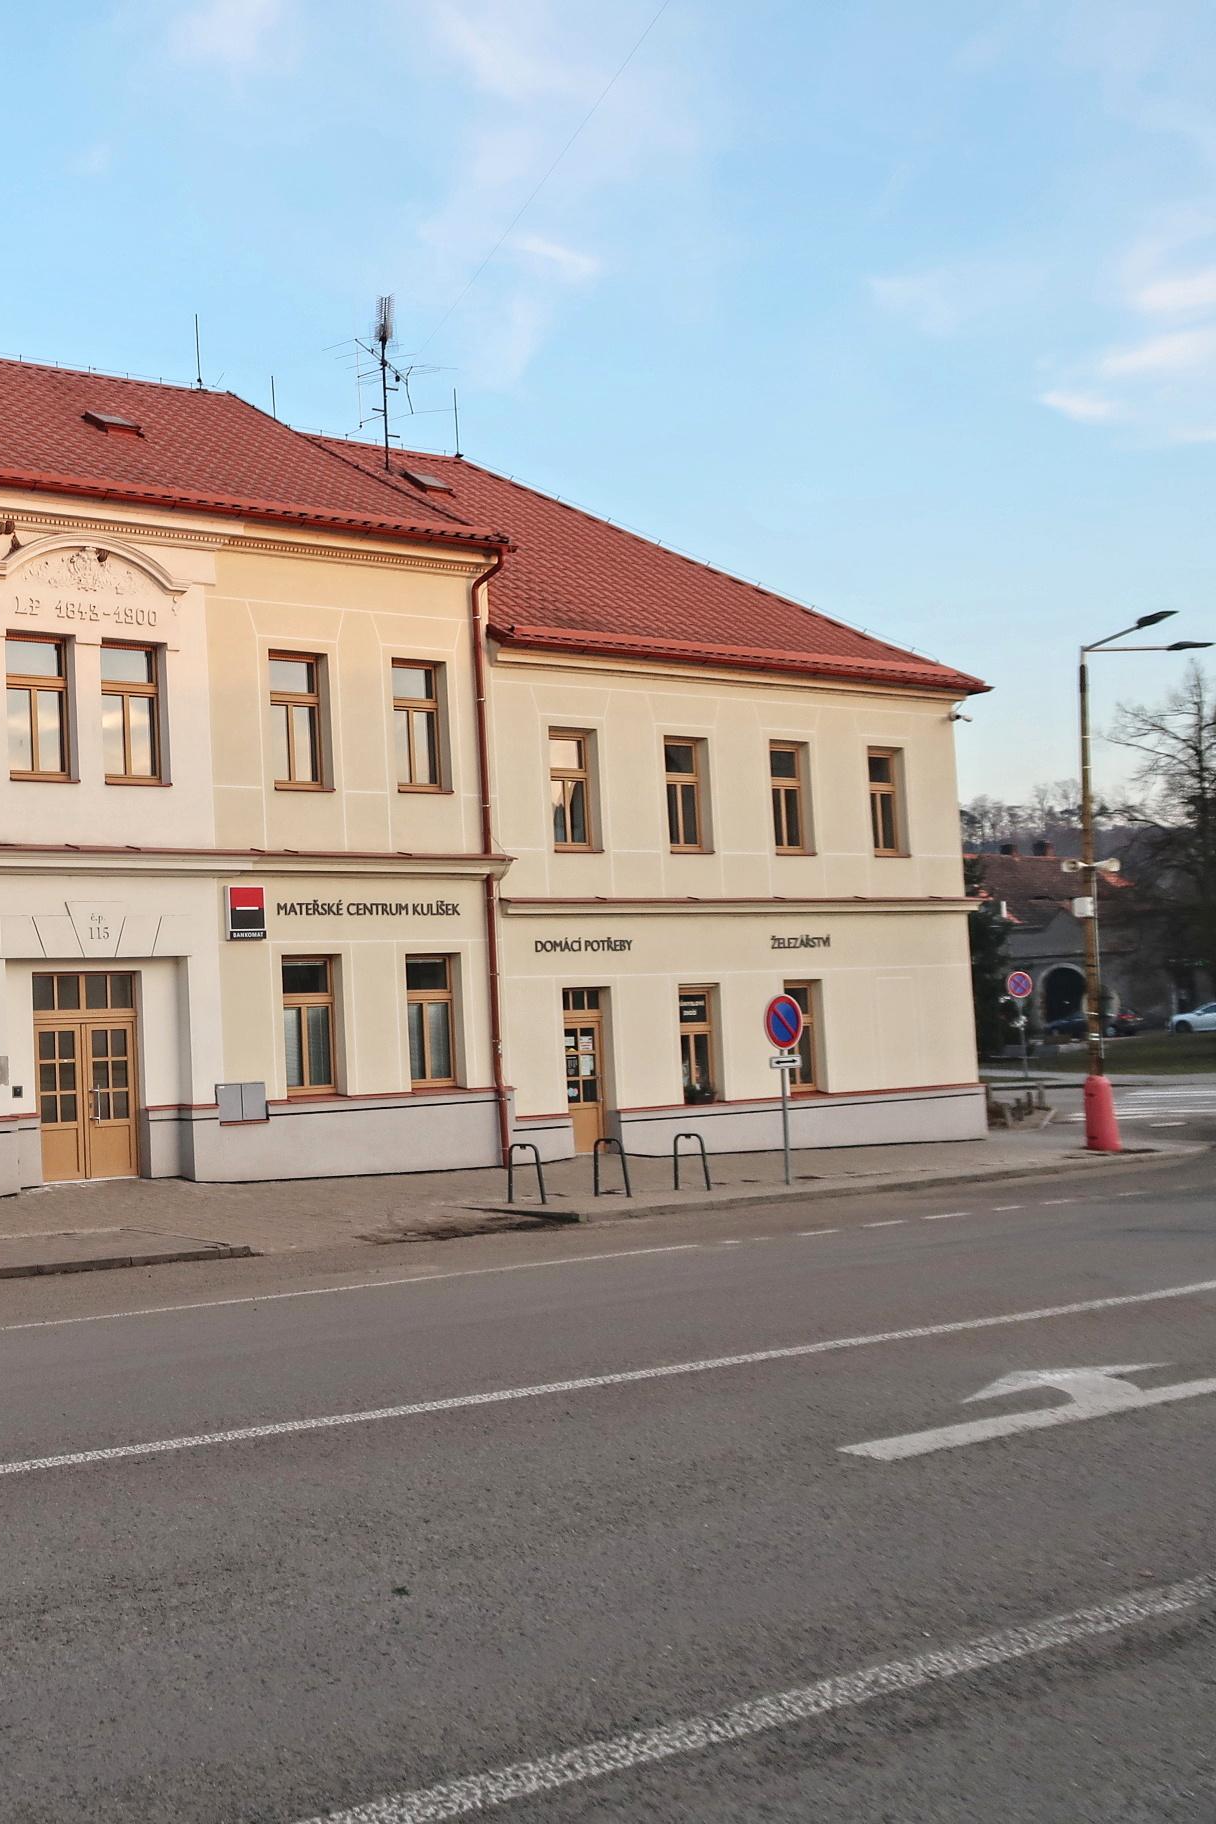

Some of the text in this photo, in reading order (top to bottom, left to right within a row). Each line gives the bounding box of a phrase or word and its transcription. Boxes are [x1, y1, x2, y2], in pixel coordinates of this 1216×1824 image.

[276, 899, 461, 916] MATEŘSKÉ CENTRUM KULÍŠEK
[89, 926, 110, 940] 115
[534, 936, 633, 953] DOMÁCÍ POTŘEBY
[771, 934, 831, 949] ŽELEZÁŘSTVÍ
